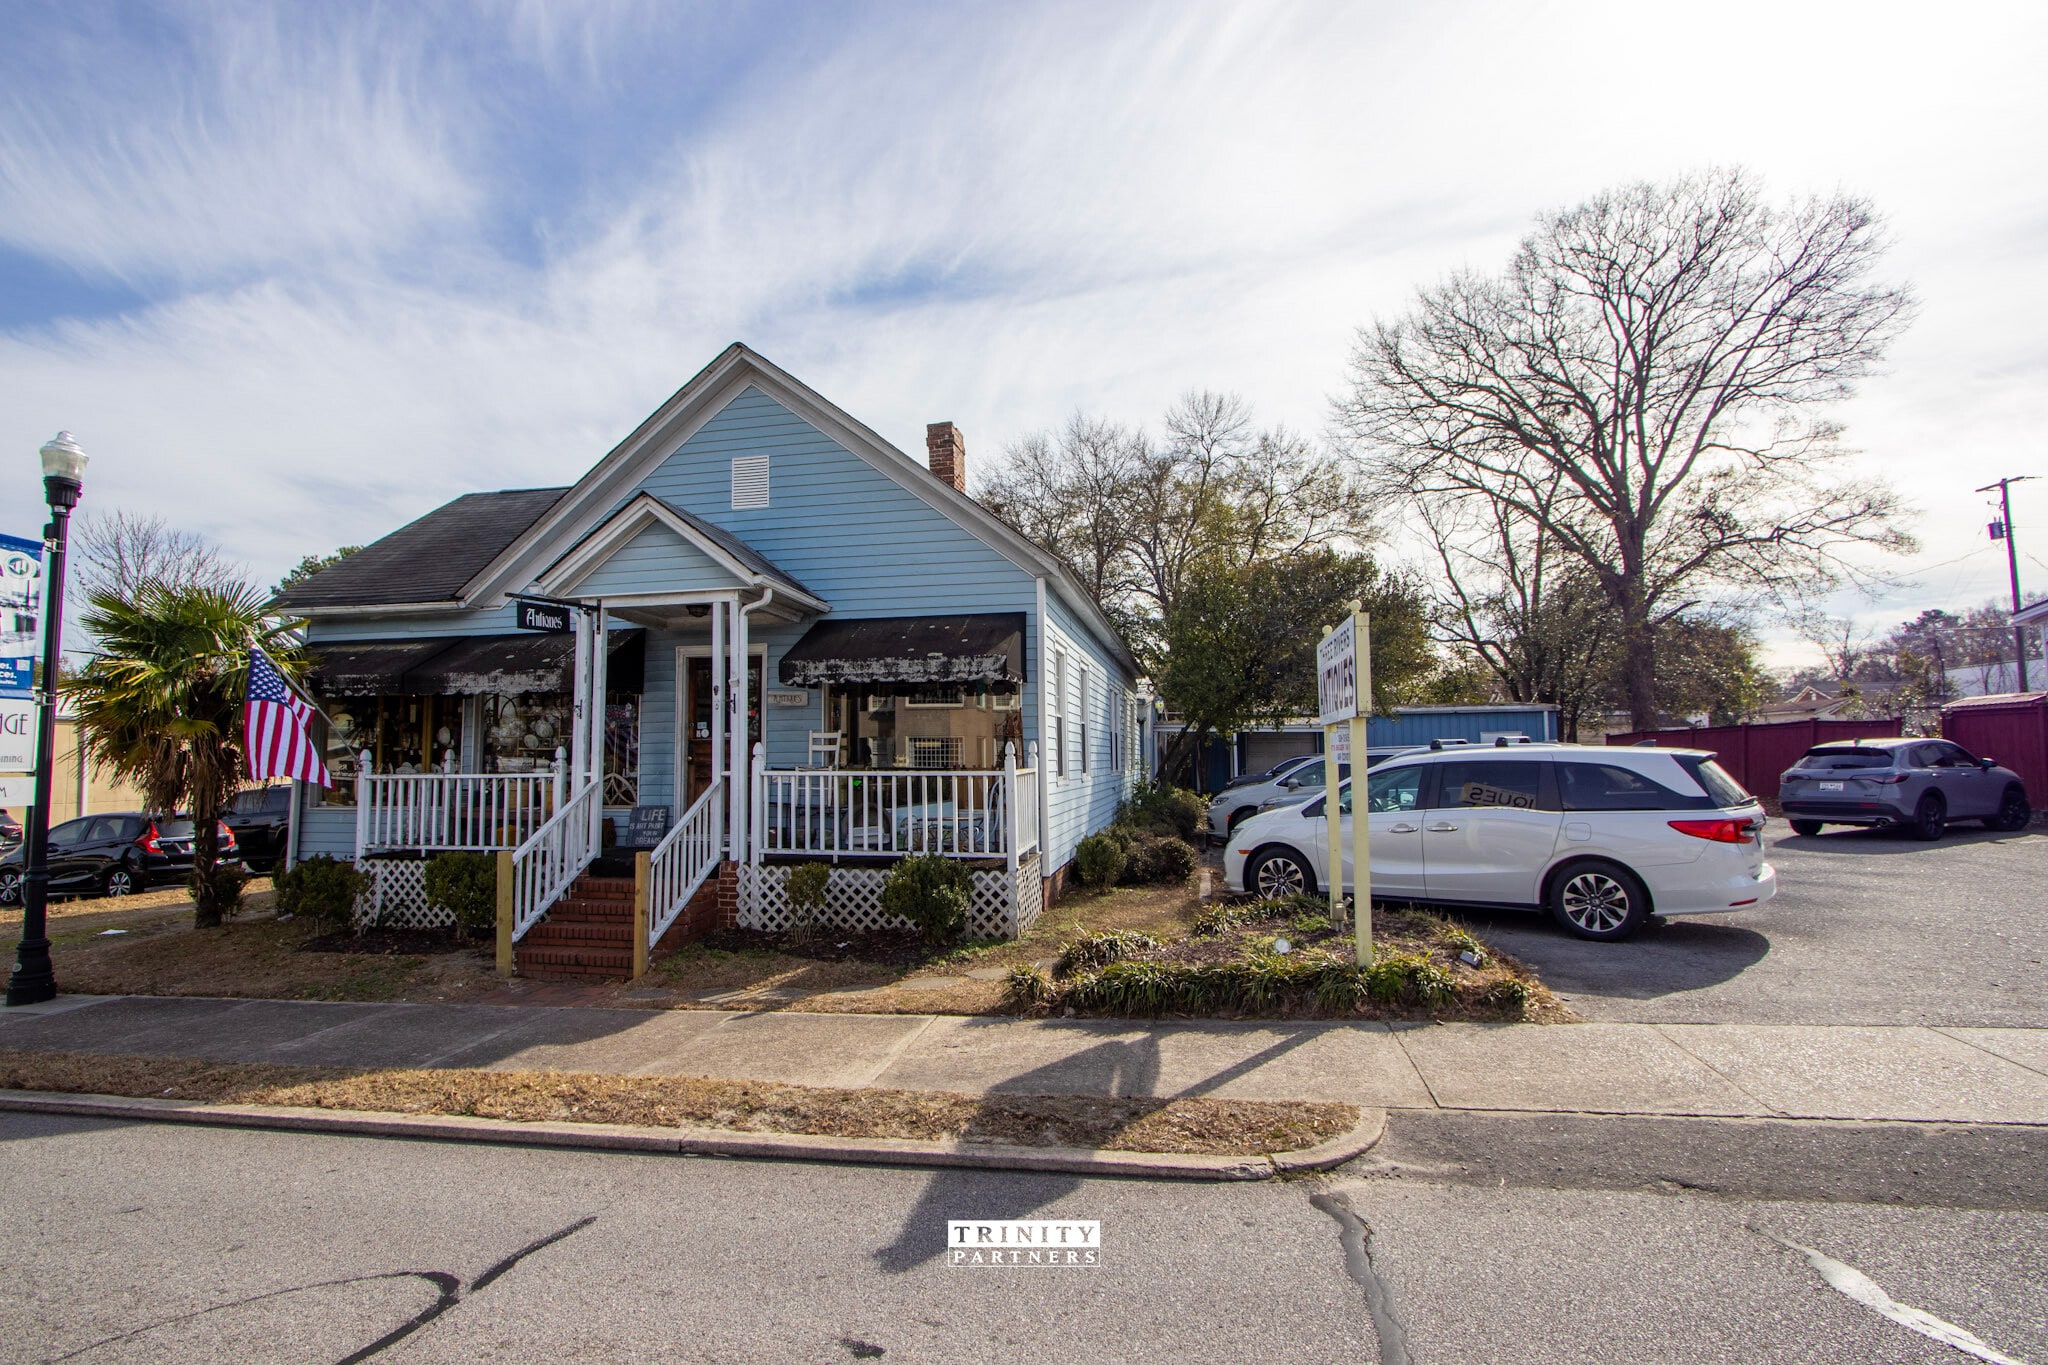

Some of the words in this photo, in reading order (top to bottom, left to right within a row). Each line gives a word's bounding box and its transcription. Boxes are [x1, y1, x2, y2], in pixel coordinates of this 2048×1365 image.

[526, 608, 563, 629] Antiques
[1333, 627, 1350, 656] RIVERS
[1320, 654, 1353, 716] ANTIQUES
[641, 808, 667, 821] LIFE
[636, 822, 647, 830] ART
